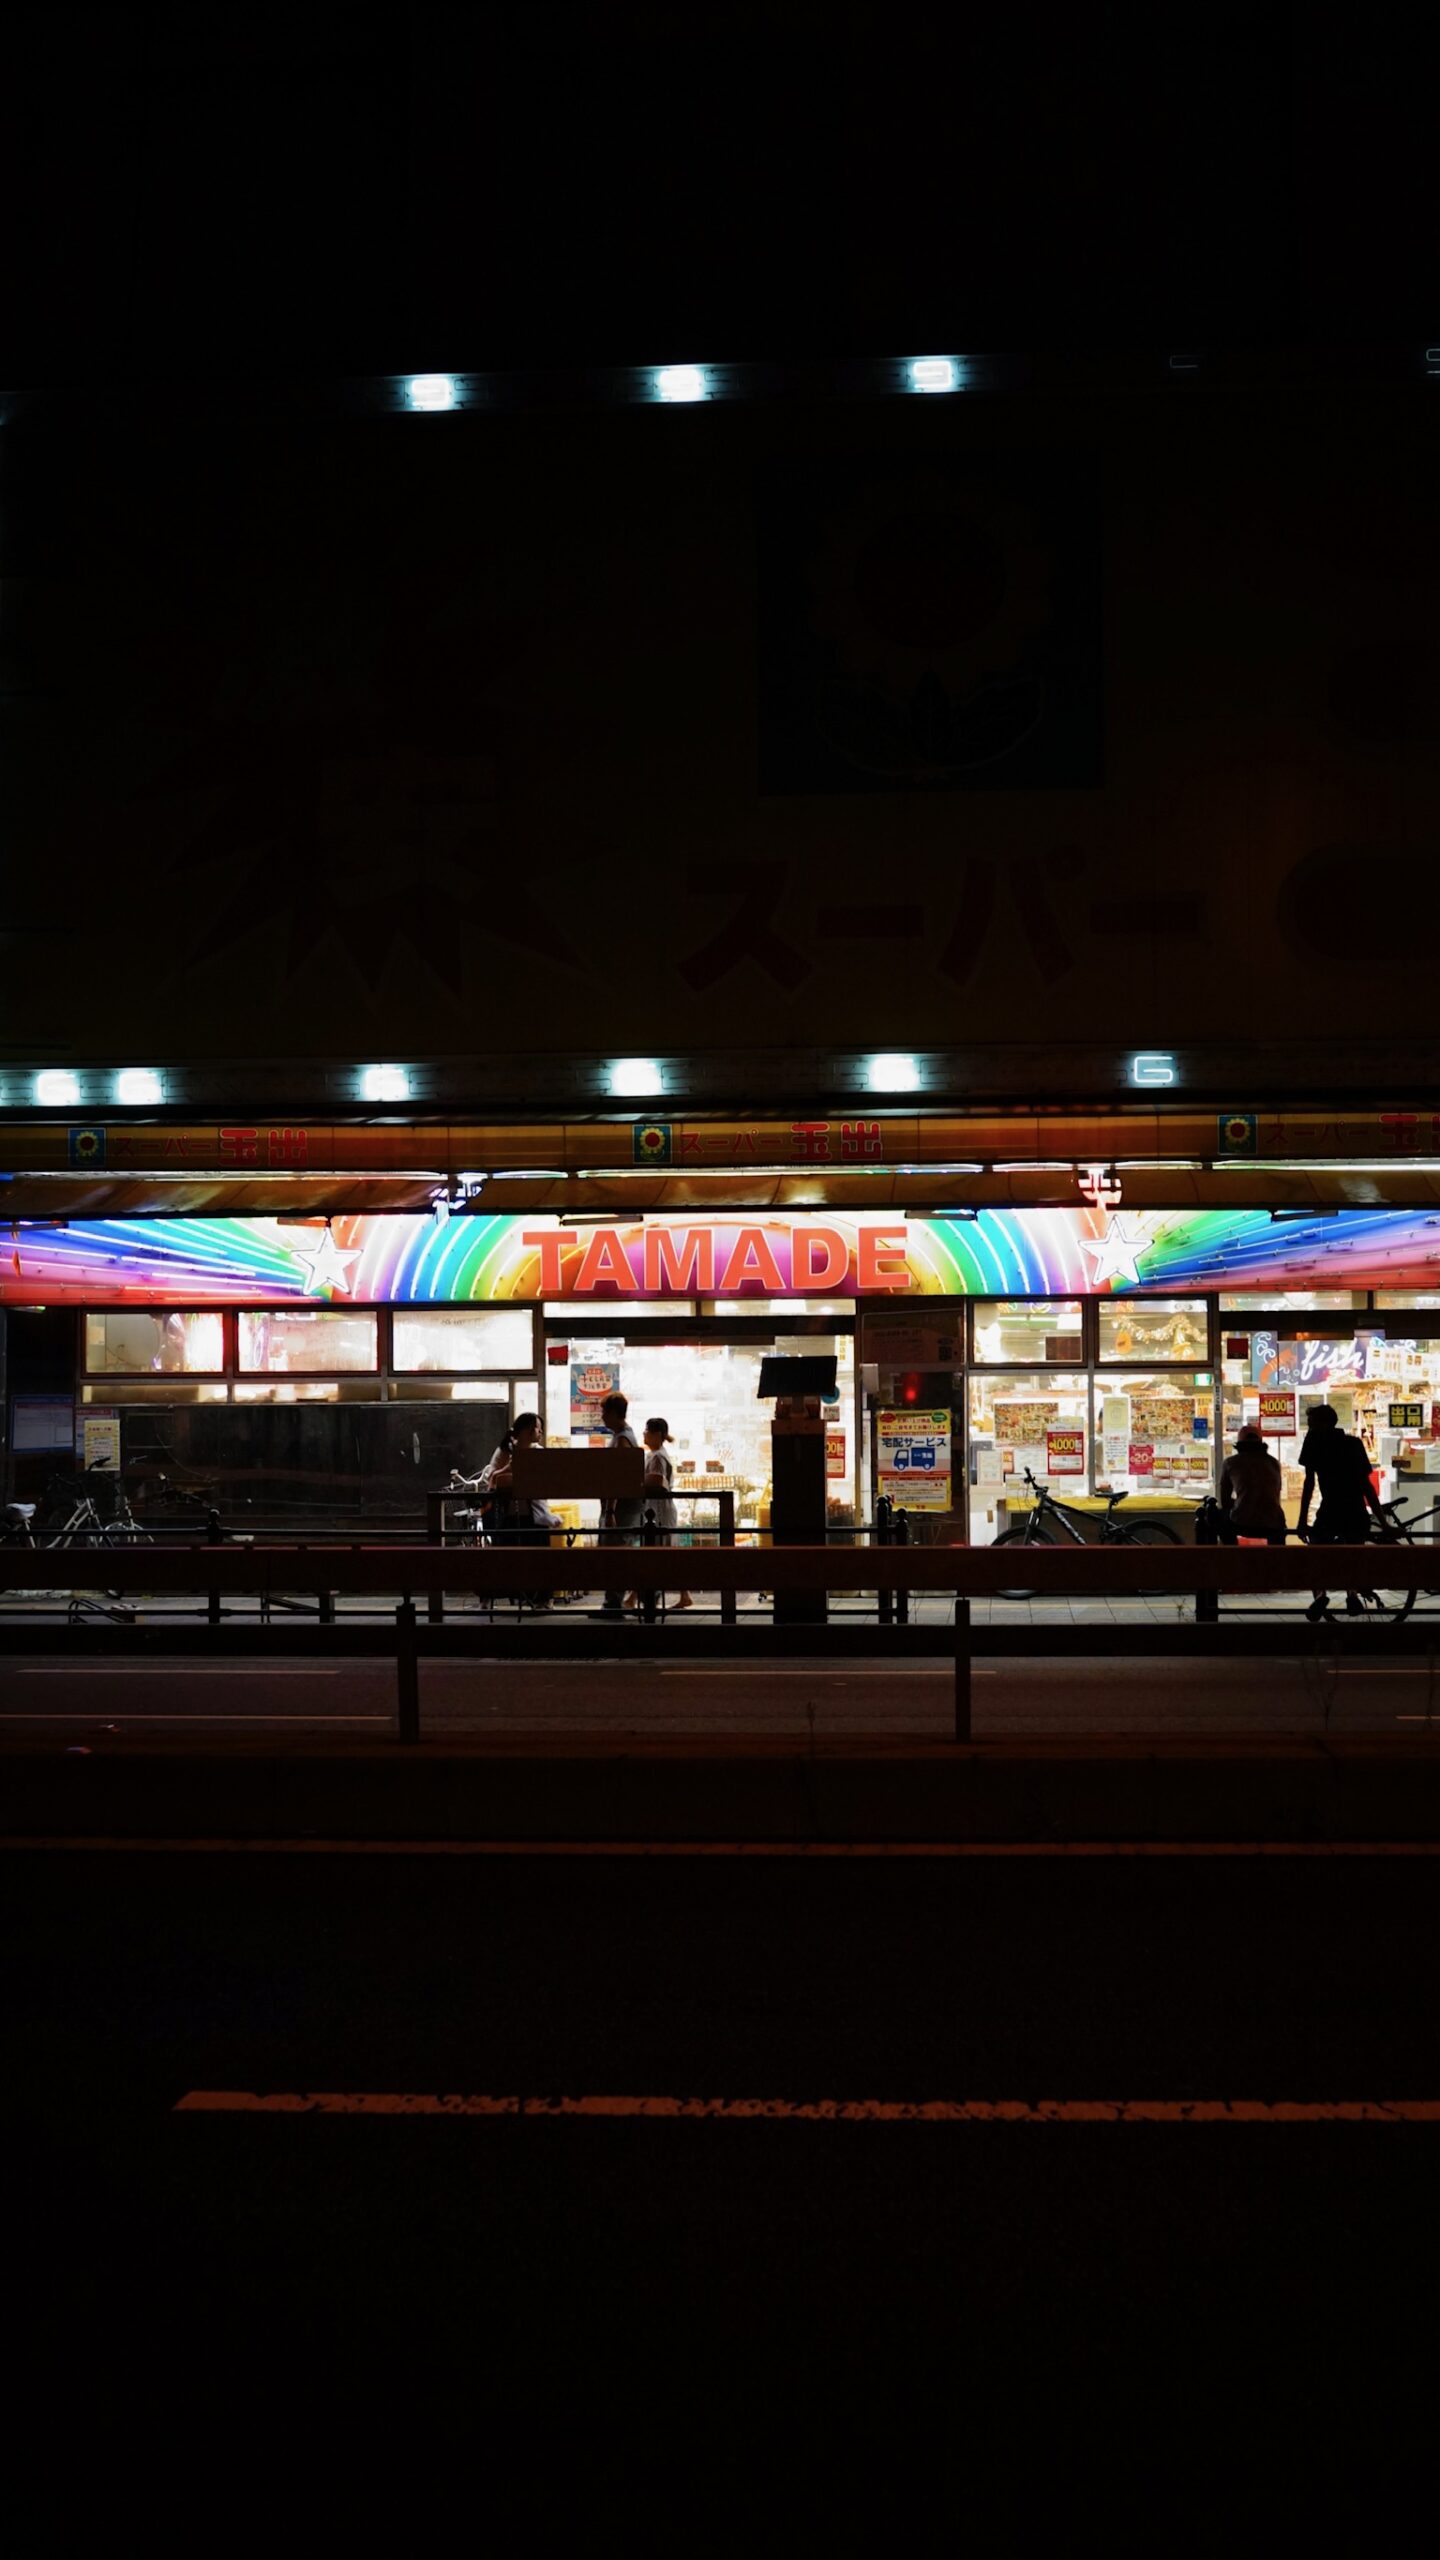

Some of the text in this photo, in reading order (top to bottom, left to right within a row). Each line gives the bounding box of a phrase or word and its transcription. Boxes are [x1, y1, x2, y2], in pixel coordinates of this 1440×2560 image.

[522, 1227, 910, 1292] TAMADE
[1300, 1337, 1364, 1381] fish
[882, 1437, 946, 1448] 宅配サービス
